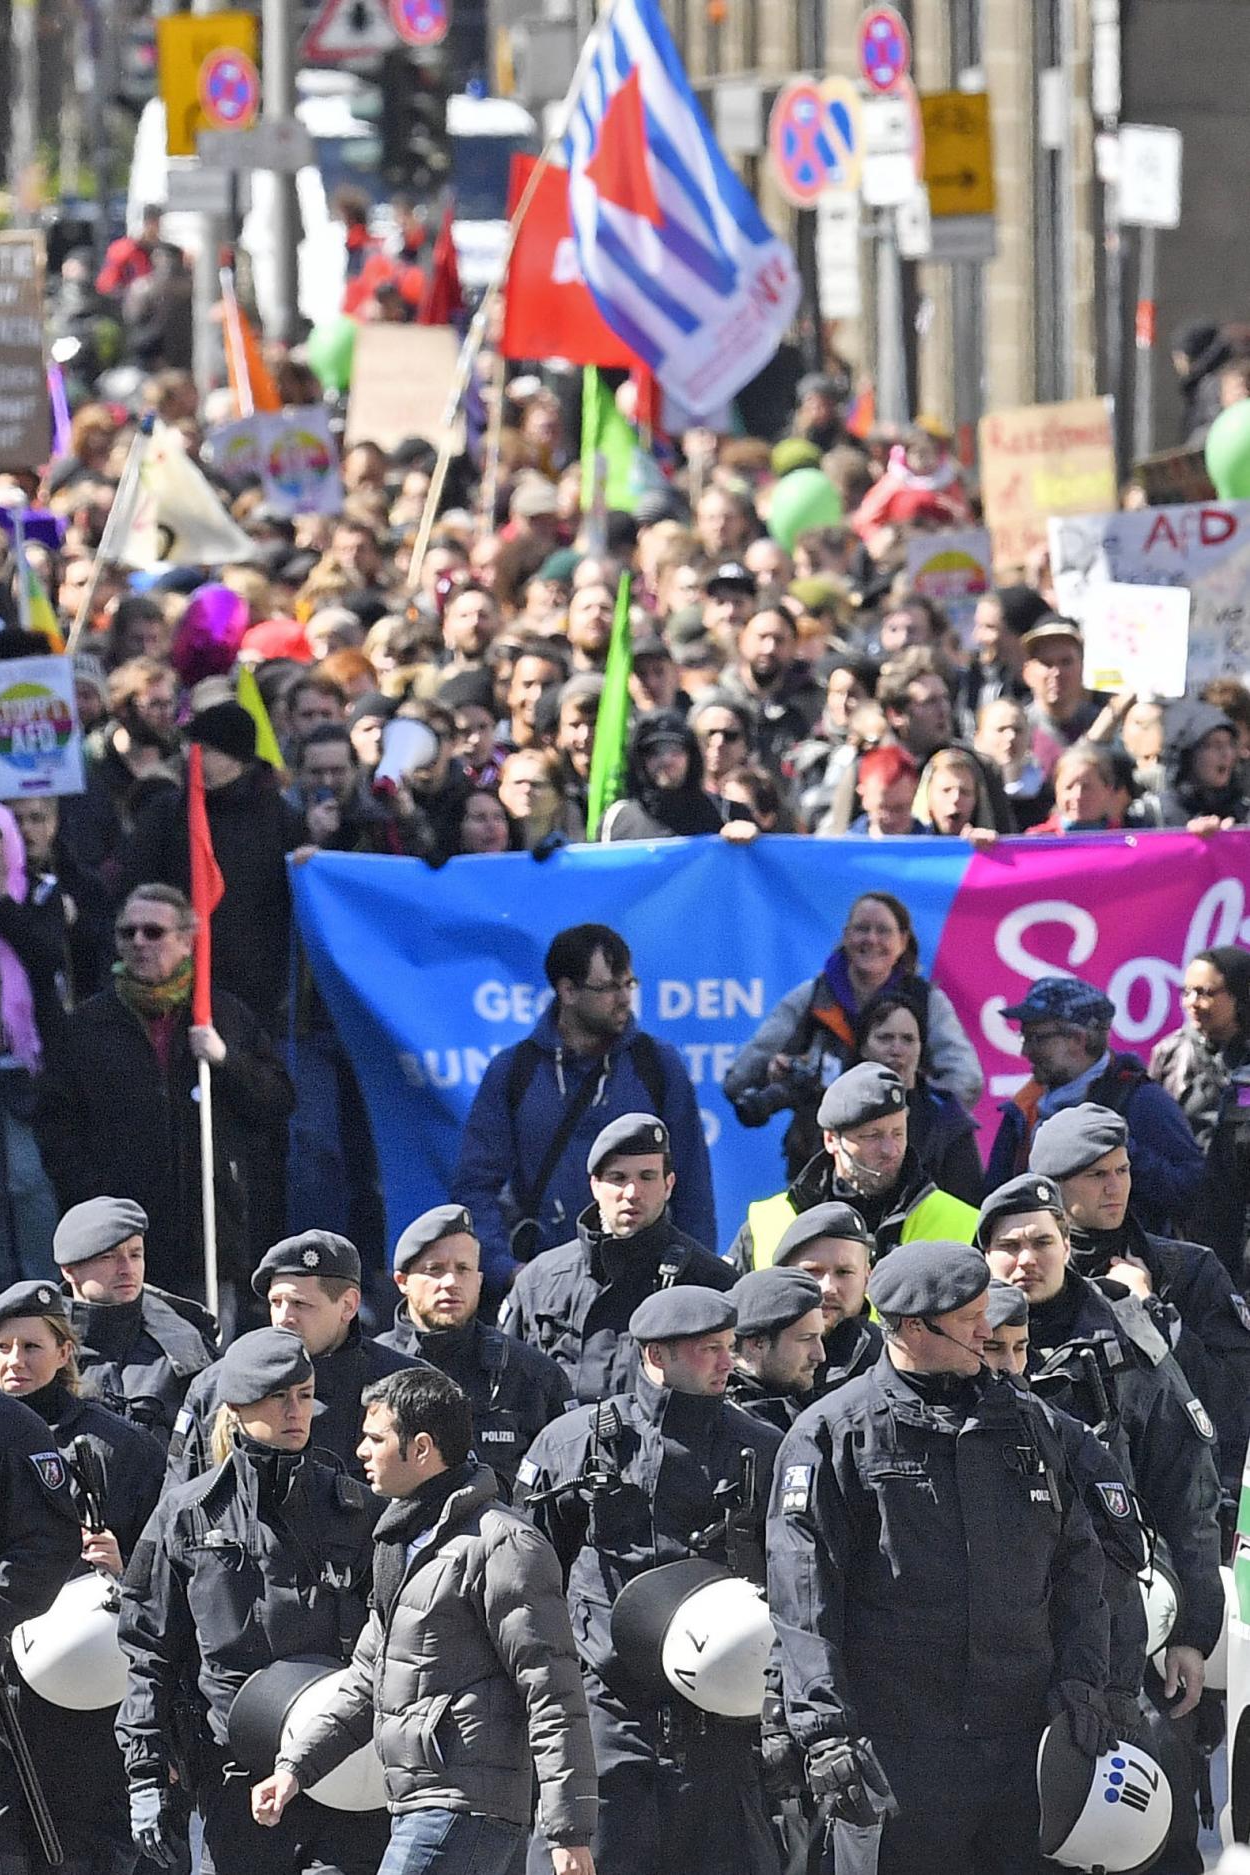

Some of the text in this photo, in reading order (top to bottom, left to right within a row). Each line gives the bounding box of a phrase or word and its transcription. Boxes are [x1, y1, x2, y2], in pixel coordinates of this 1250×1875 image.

[1142, 508, 1238, 561] AfD
[659, 979, 763, 1020] DEN
[482, 1430, 516, 1443] POLIZEI
[1030, 1489, 1051, 1502] POLIZ
